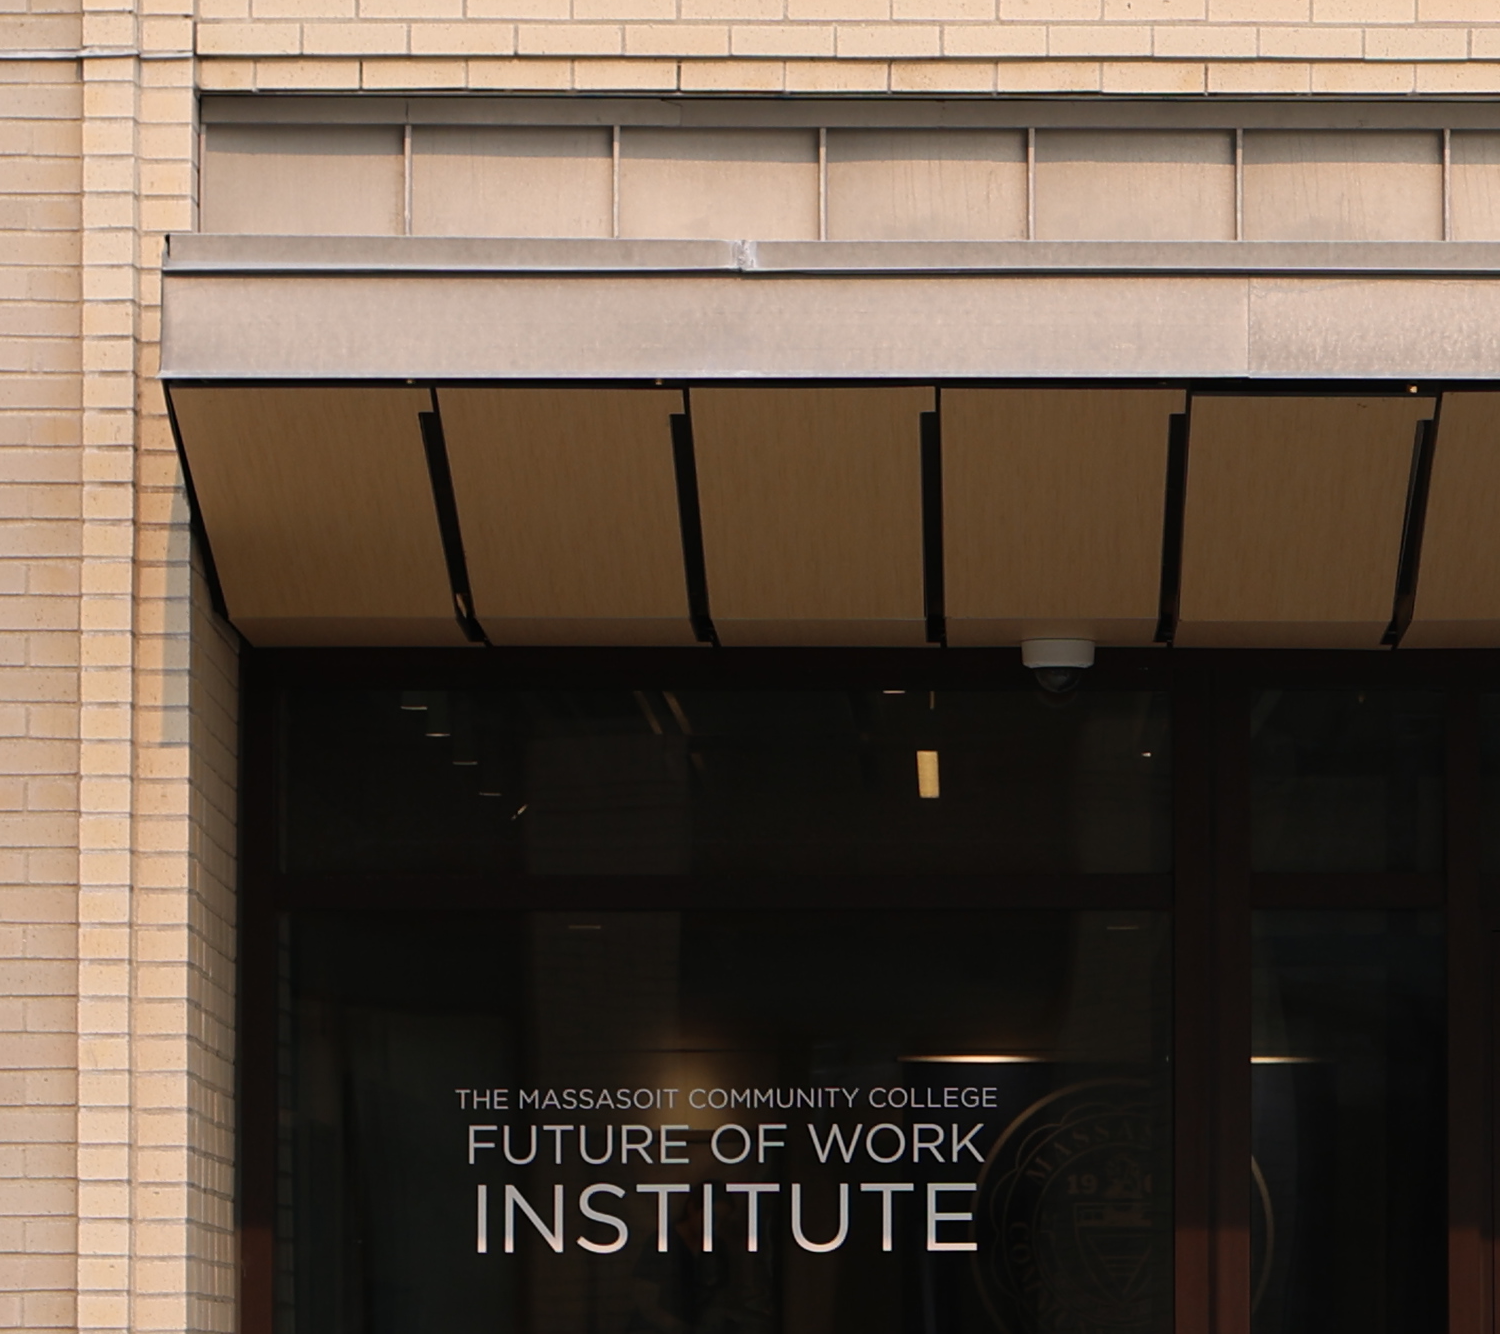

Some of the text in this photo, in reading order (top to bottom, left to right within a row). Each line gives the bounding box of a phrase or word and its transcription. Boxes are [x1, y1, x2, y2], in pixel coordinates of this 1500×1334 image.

[455, 1087, 998, 1110] THE MASSASOIT COMMUNITY COLLEGE
[467, 1123, 986, 1166] FUTURE OF WORK
[476, 1181, 979, 1254] INSTITUTE
